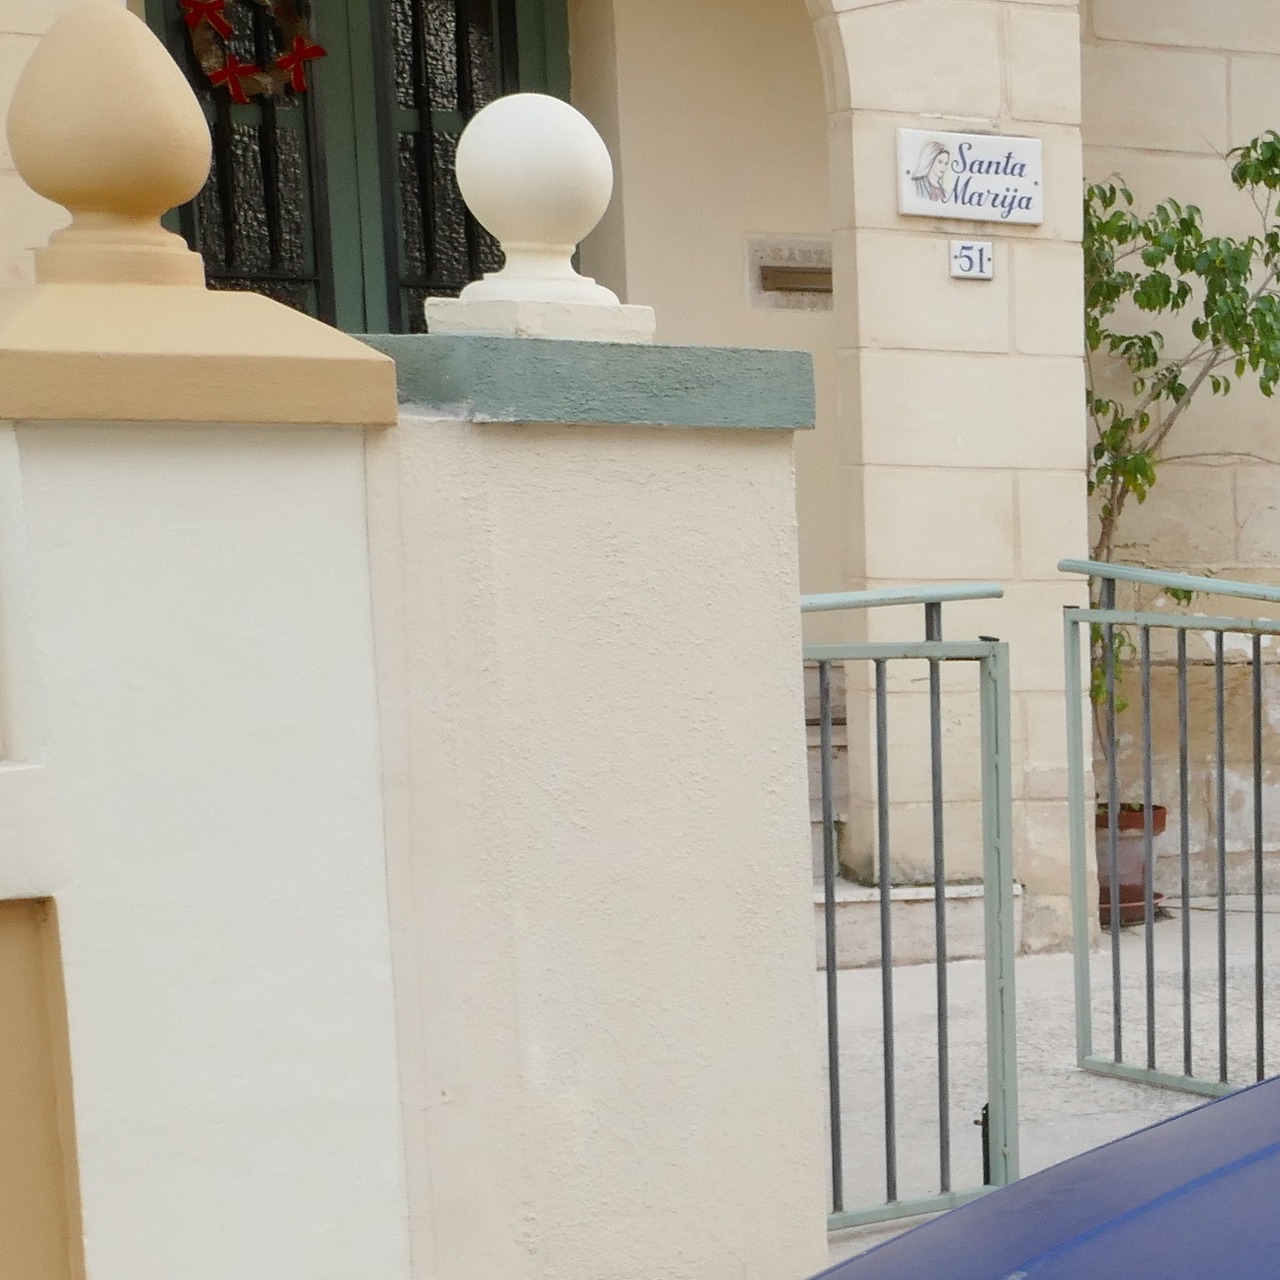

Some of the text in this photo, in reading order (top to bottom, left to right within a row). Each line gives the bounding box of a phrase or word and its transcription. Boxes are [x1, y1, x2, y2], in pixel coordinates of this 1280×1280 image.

[951, 142, 1027, 178] Santa
[942, 175, 1033, 219] Marija
[959, 245, 986, 274] 51
